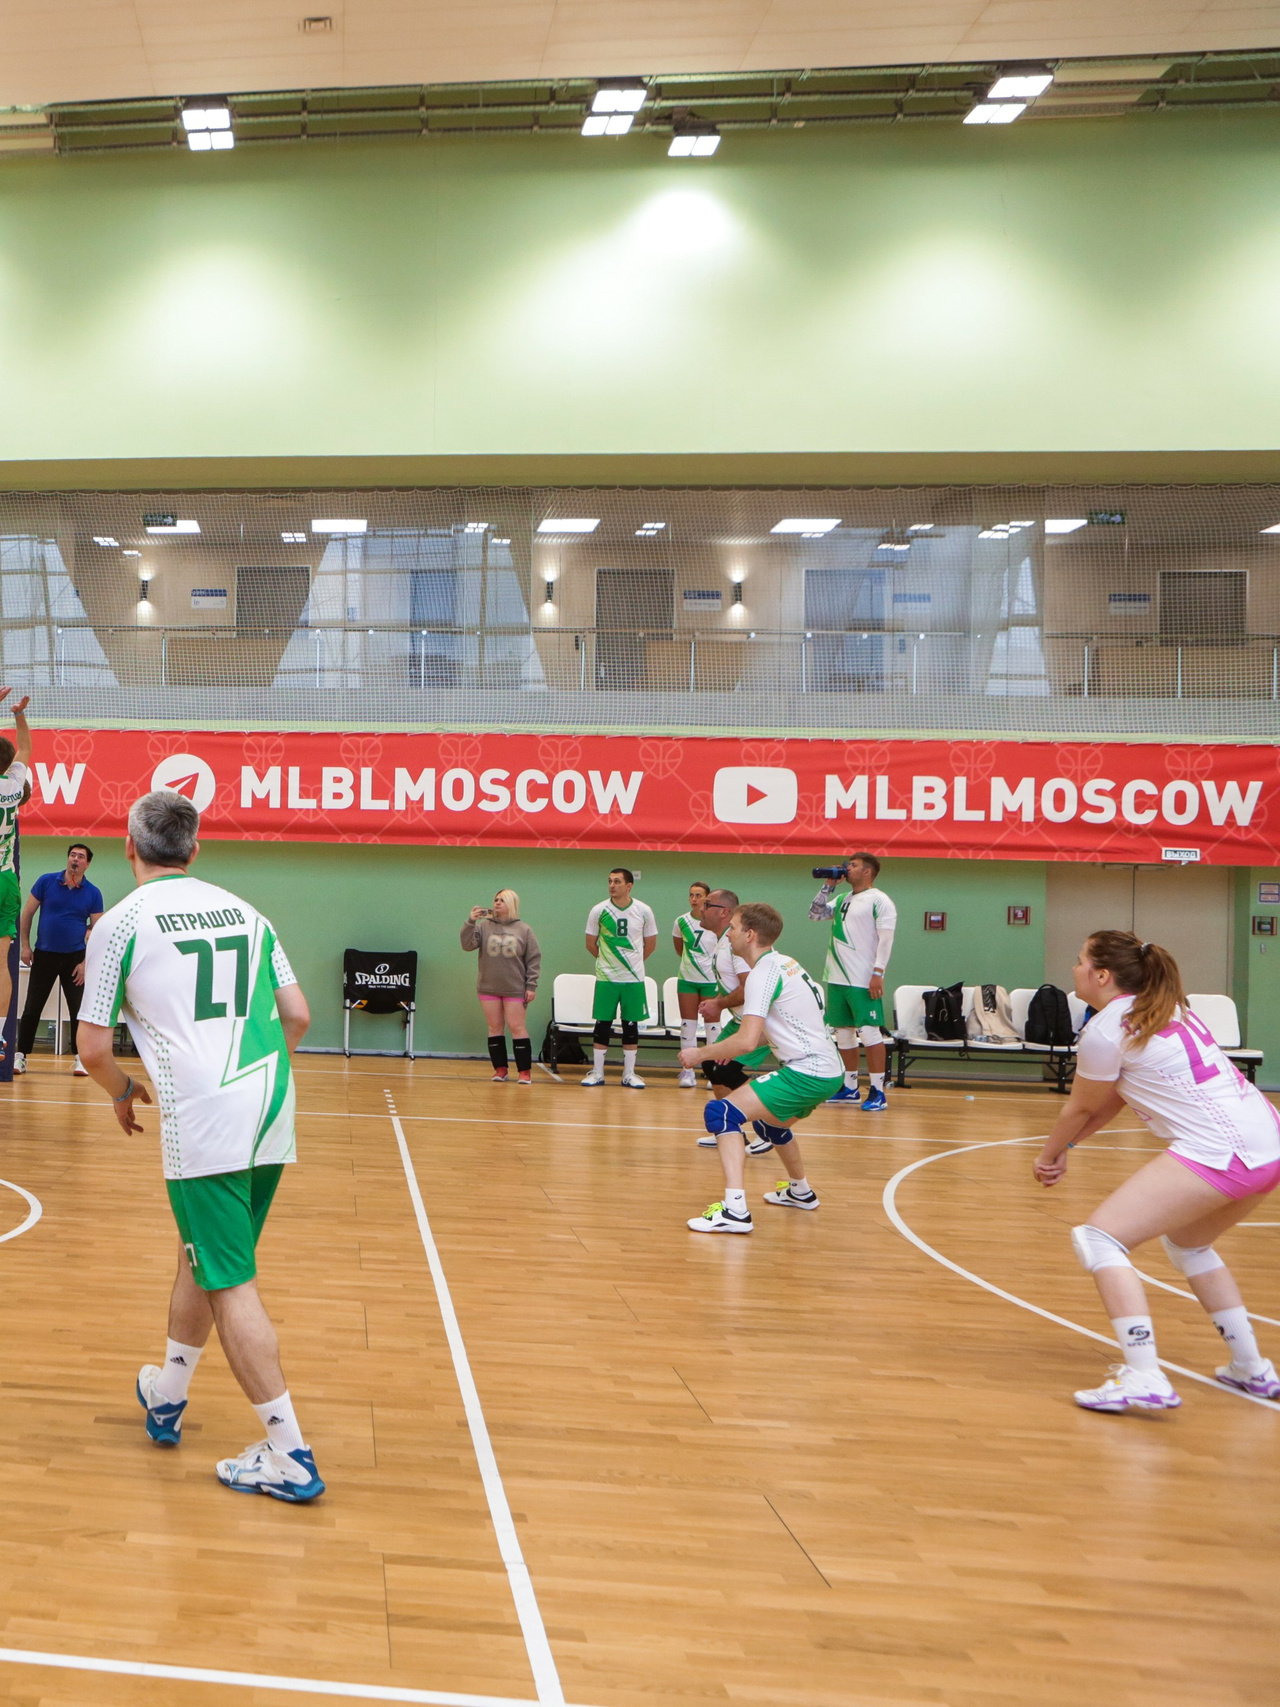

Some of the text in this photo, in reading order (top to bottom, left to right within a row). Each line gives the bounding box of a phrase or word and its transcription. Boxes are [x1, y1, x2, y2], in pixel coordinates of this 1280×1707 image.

[240, 766, 644, 815] MLBLMOSCOW
[824, 774, 1264, 827] MLBLMOSCOW
[155, 908, 246, 933] ПЕТРАШОВ
[840, 902, 850, 921] 4
[616, 918, 628, 937] 8
[693, 930, 704, 948] 7
[173, 934, 250, 1022] 27
[355, 972, 410, 987] SPALDING
[869, 1010, 877, 1020] 4
